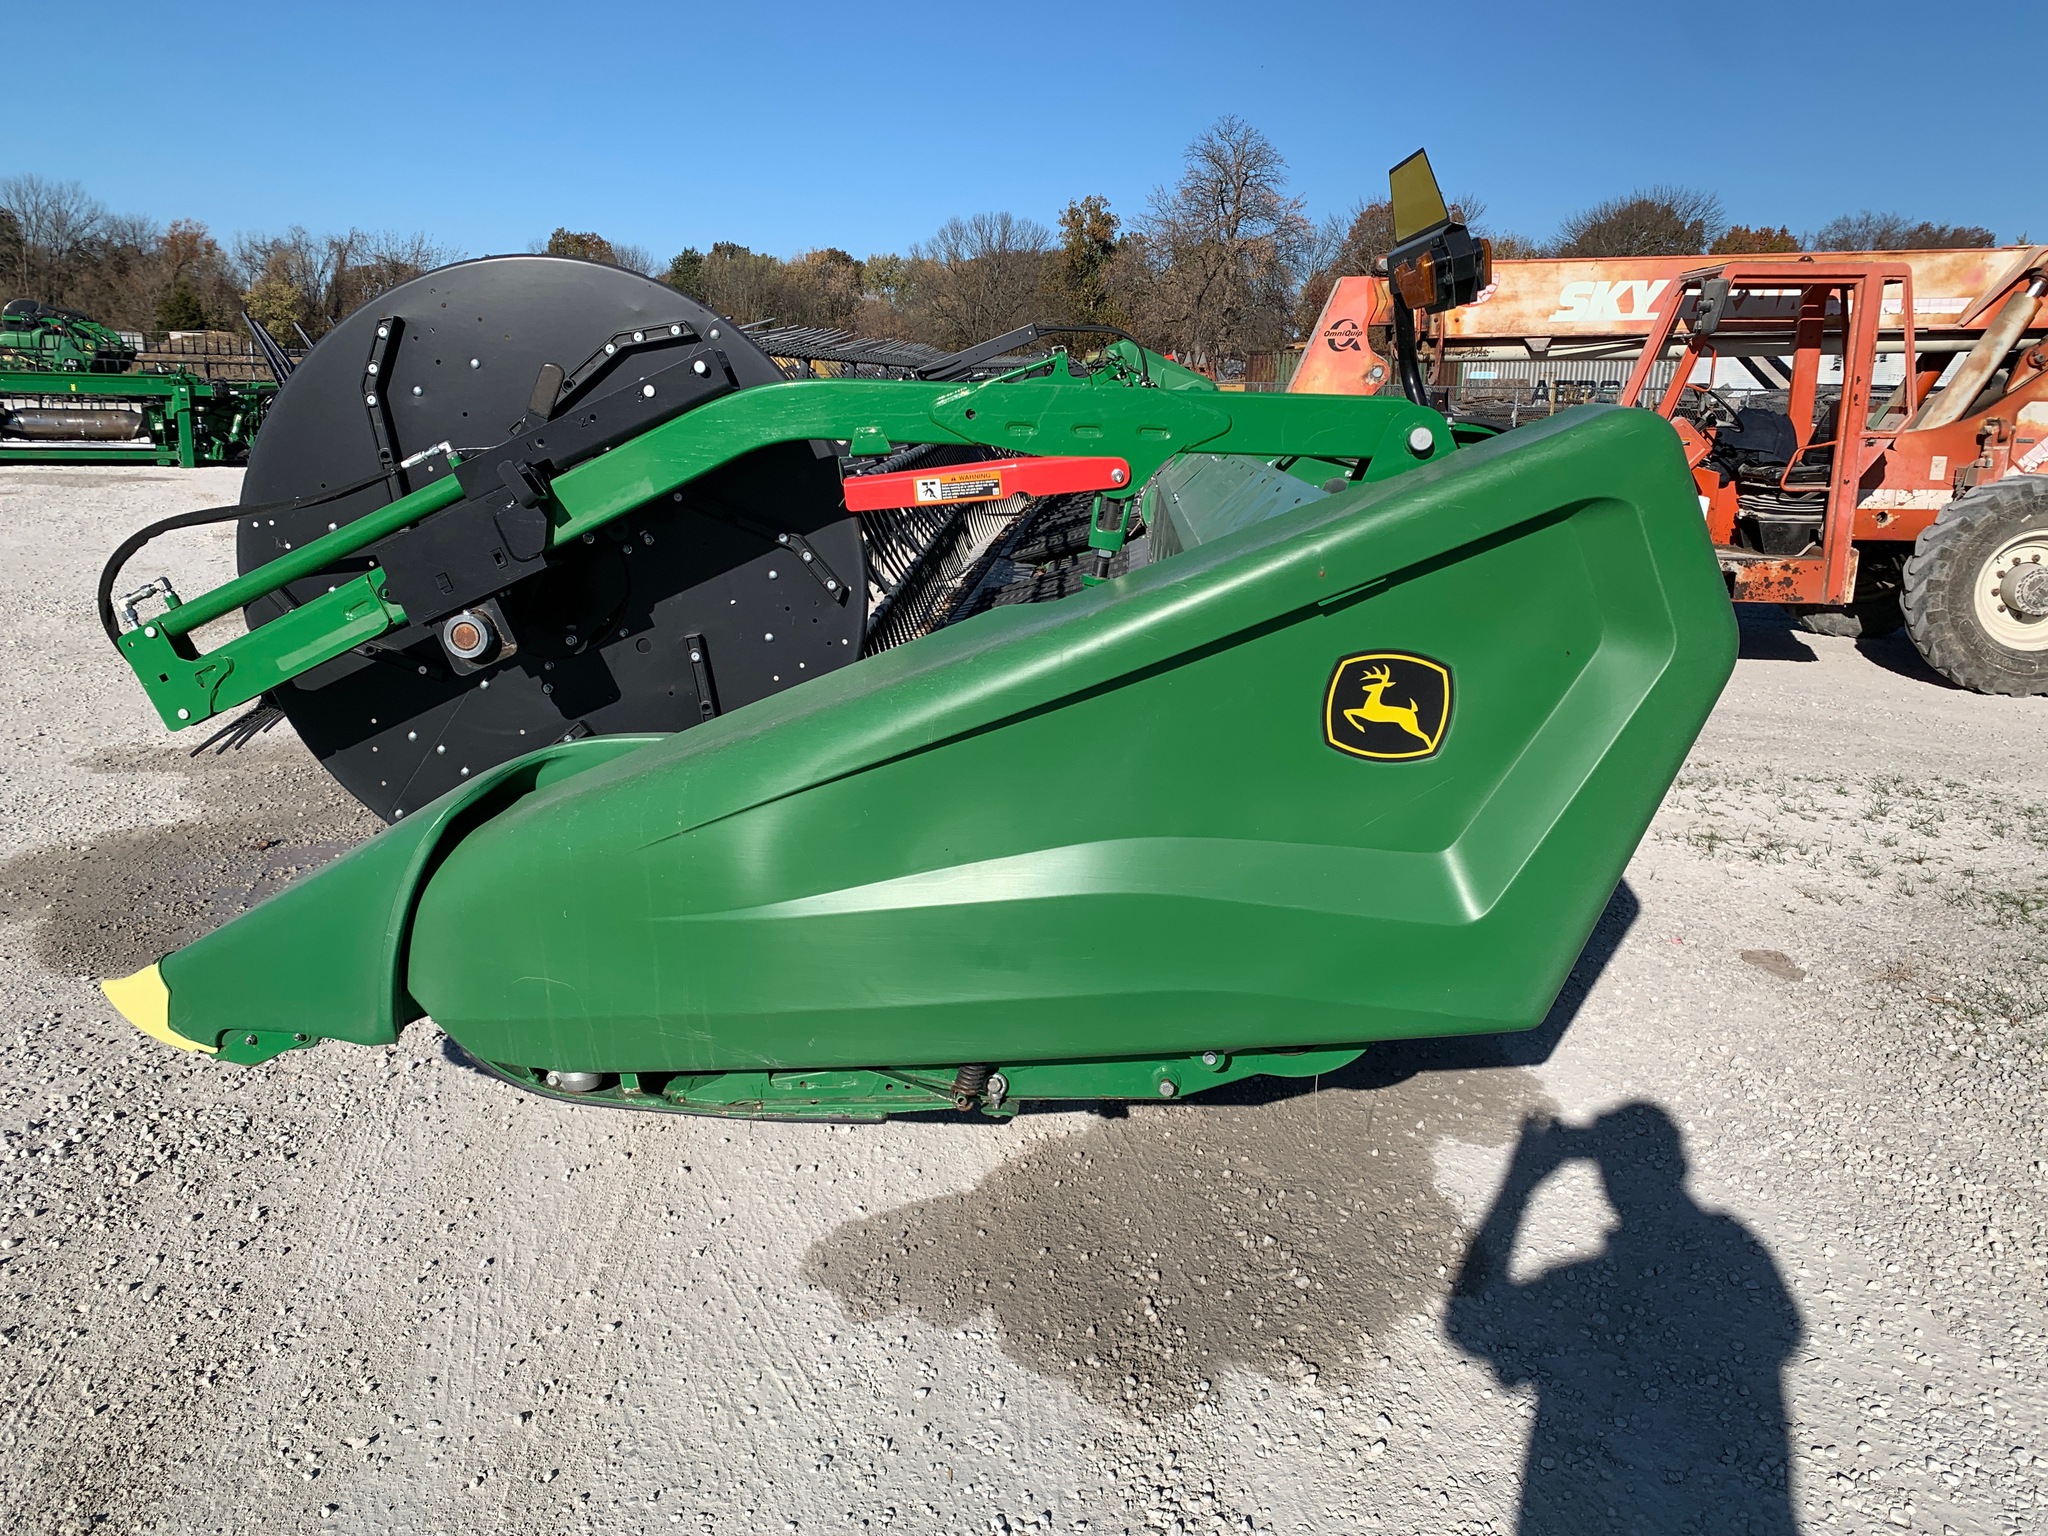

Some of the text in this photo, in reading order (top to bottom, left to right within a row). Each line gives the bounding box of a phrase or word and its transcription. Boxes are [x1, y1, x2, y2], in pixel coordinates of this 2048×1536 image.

[578, 417, 589, 429] 2
[635, 391, 645, 402] 3
[689, 365, 697, 376] 4
